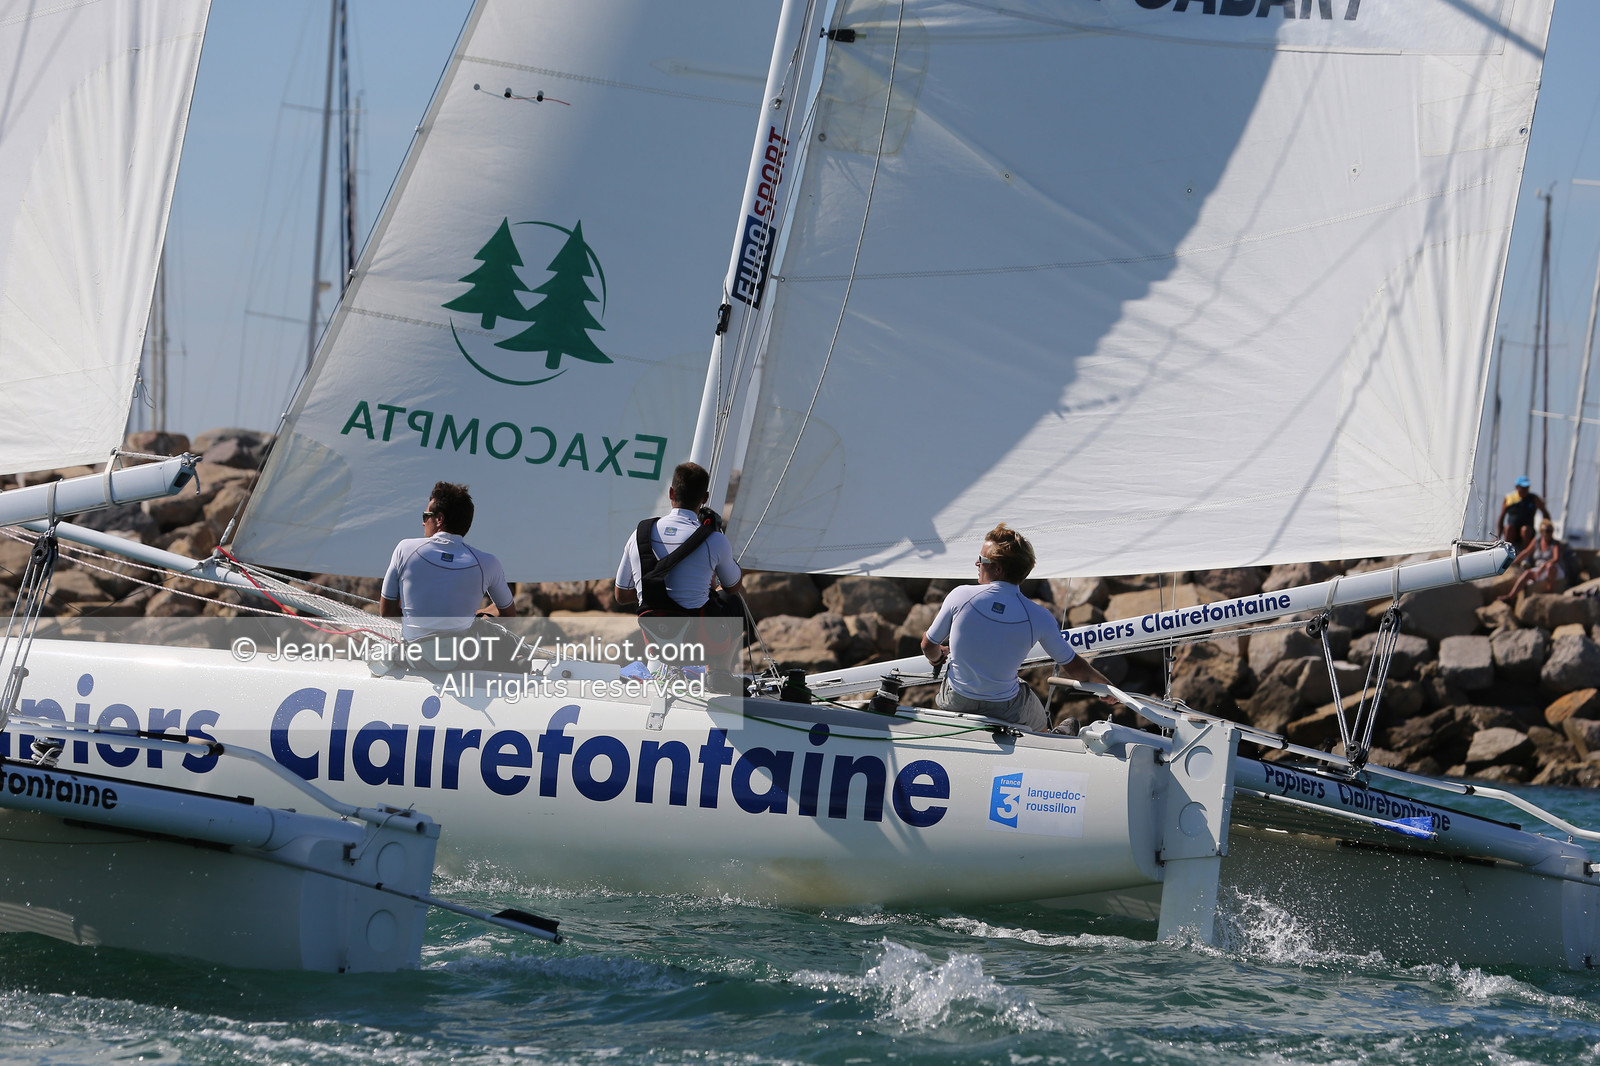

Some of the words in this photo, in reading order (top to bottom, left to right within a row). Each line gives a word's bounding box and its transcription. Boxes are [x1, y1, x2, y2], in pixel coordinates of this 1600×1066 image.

[1141, 594, 1291, 633] Clairefontaine
[270, 687, 950, 827] Clairefontaine
[1001, 778, 1021, 786] france
[1263, 763, 1326, 799] Papiers
[997, 786, 1021, 819] 3
[1026, 802, 1077, 814] roussillon
